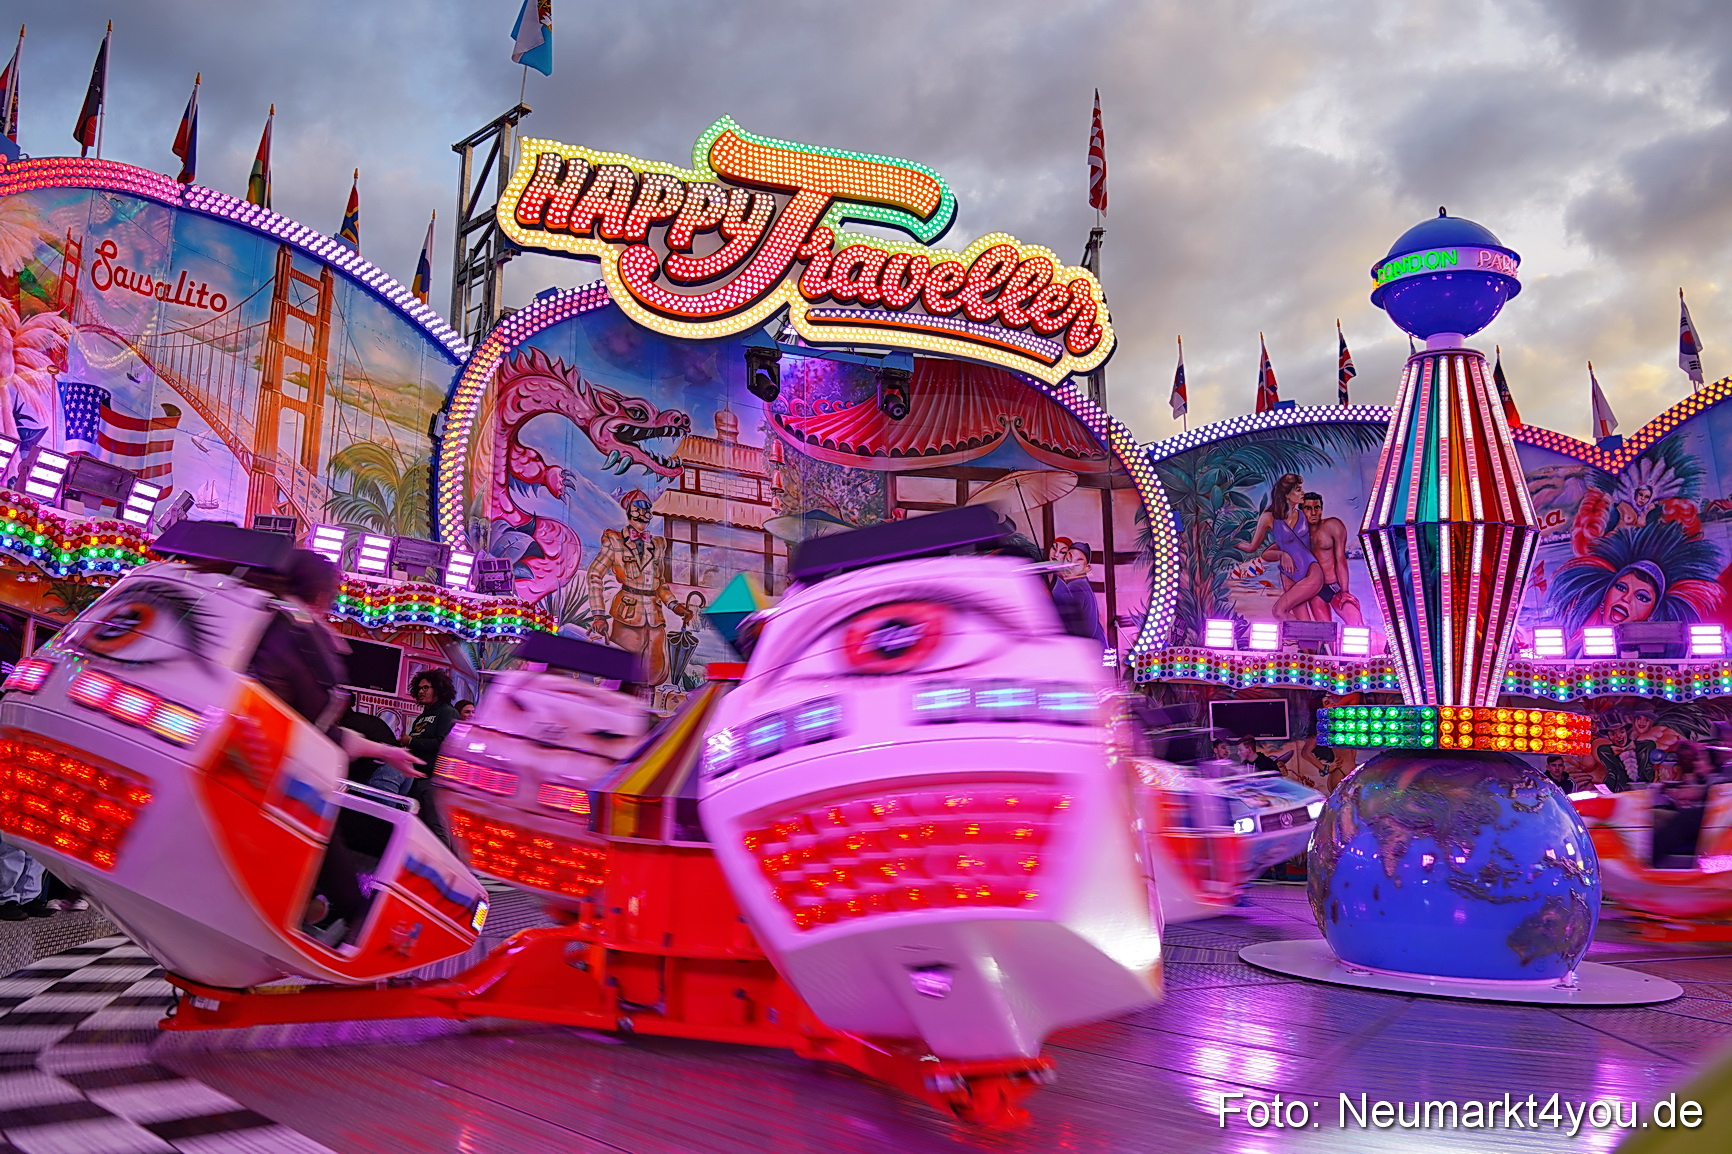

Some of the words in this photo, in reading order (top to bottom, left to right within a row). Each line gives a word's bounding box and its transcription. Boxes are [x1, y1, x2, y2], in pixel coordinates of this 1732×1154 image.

[91, 239, 228, 313] Sausalito
[617, 128, 1104, 354] Traveller
[1377, 248, 1458, 285] LONDON
